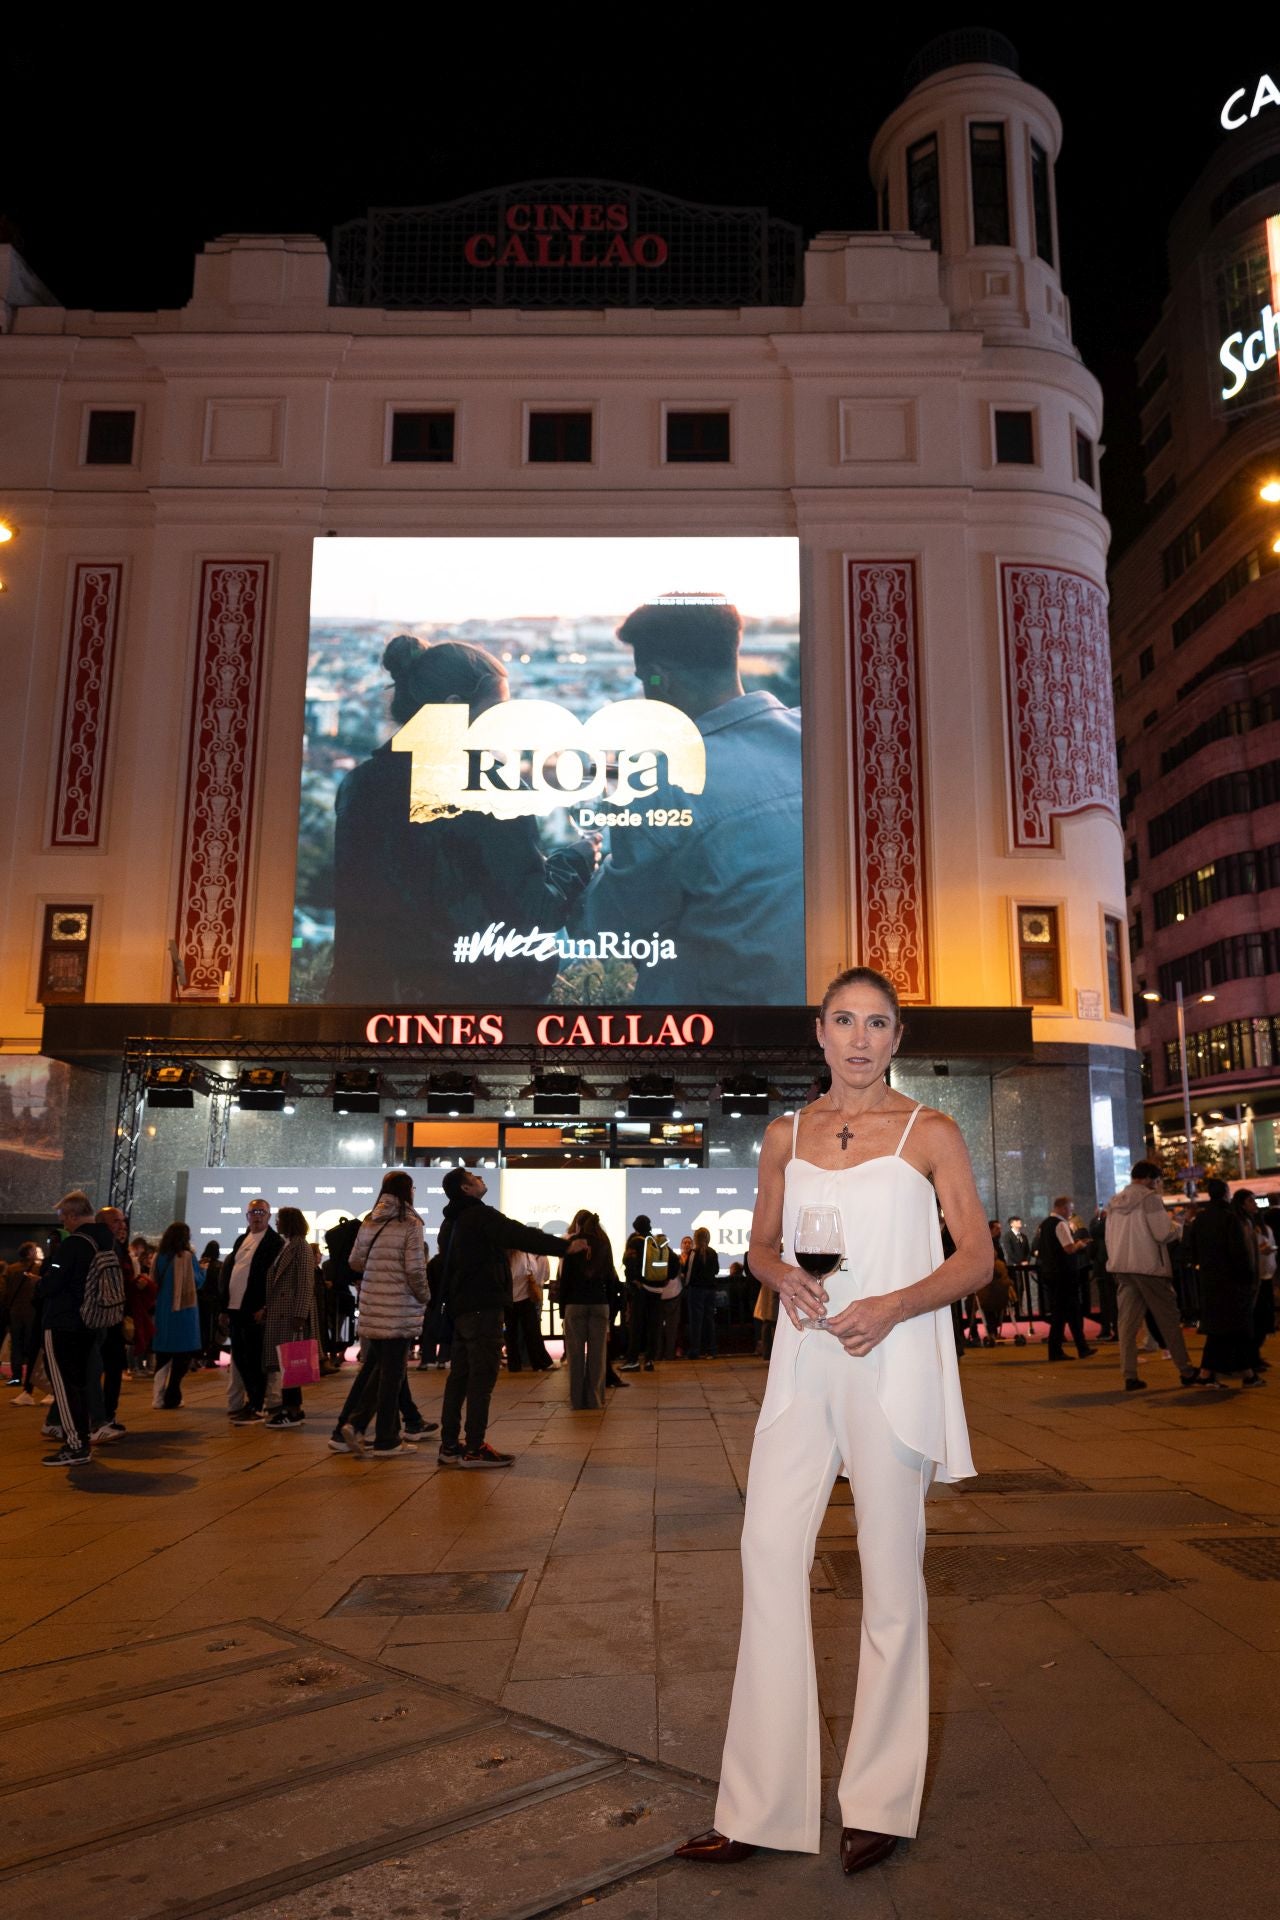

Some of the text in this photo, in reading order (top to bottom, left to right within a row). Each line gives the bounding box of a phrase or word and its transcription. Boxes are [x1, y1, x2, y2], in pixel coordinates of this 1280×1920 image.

[506, 204, 629, 231] CINES
[464, 233, 668, 268] CALLAO
[579, 808, 693, 827] Desde 1925
[365, 1013, 714, 1047] CINES CALLAO
